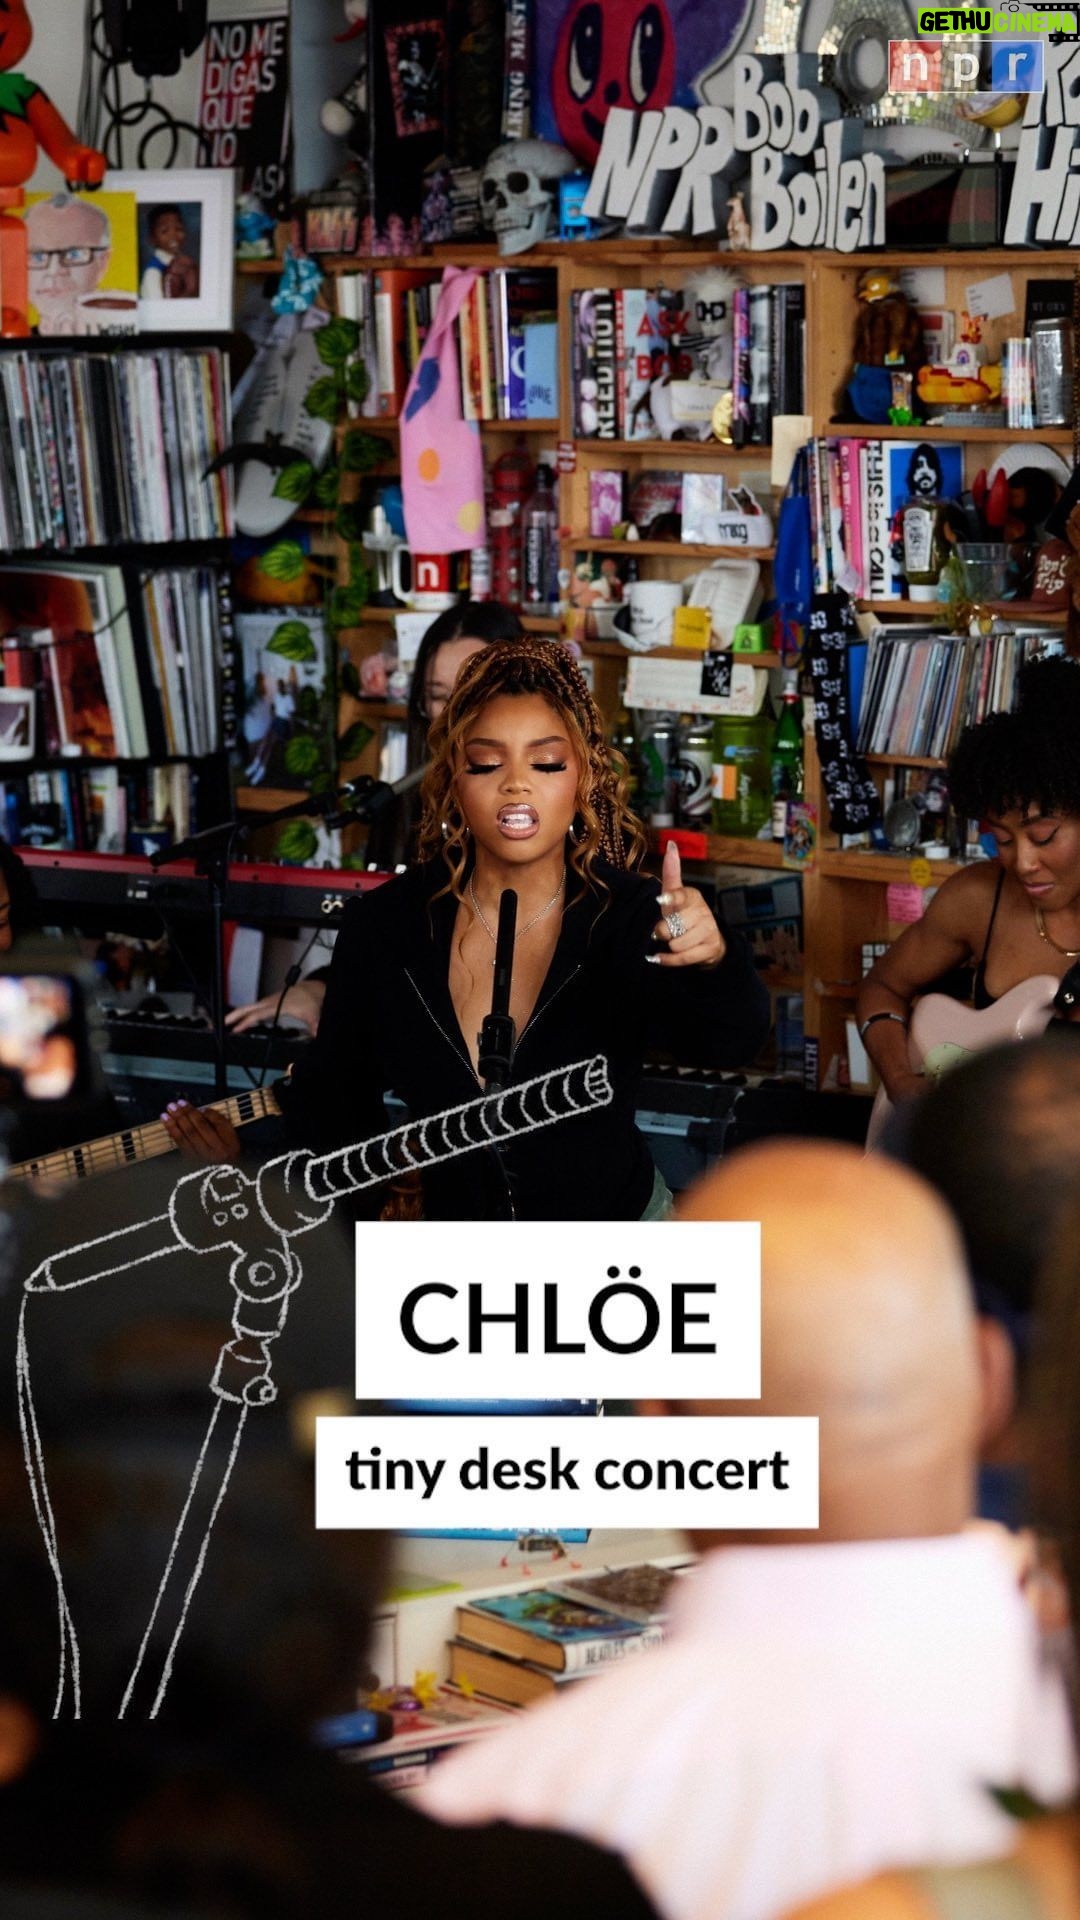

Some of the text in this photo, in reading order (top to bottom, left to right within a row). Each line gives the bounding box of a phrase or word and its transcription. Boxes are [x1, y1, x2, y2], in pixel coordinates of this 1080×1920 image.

[209, 21, 286, 60] NO ME
[206, 58, 276, 96] DIGAS
[203, 96, 253, 131] QUE
[734, 54, 820, 157] Bob
[580, 106, 734, 236] NPR
[751, 119, 887, 253] Boilen
[636, 309, 692, 337] ASK
[635, 353, 693, 381] BOB
[867, 440, 884, 498] THIS
[418, 561, 440, 588] n
